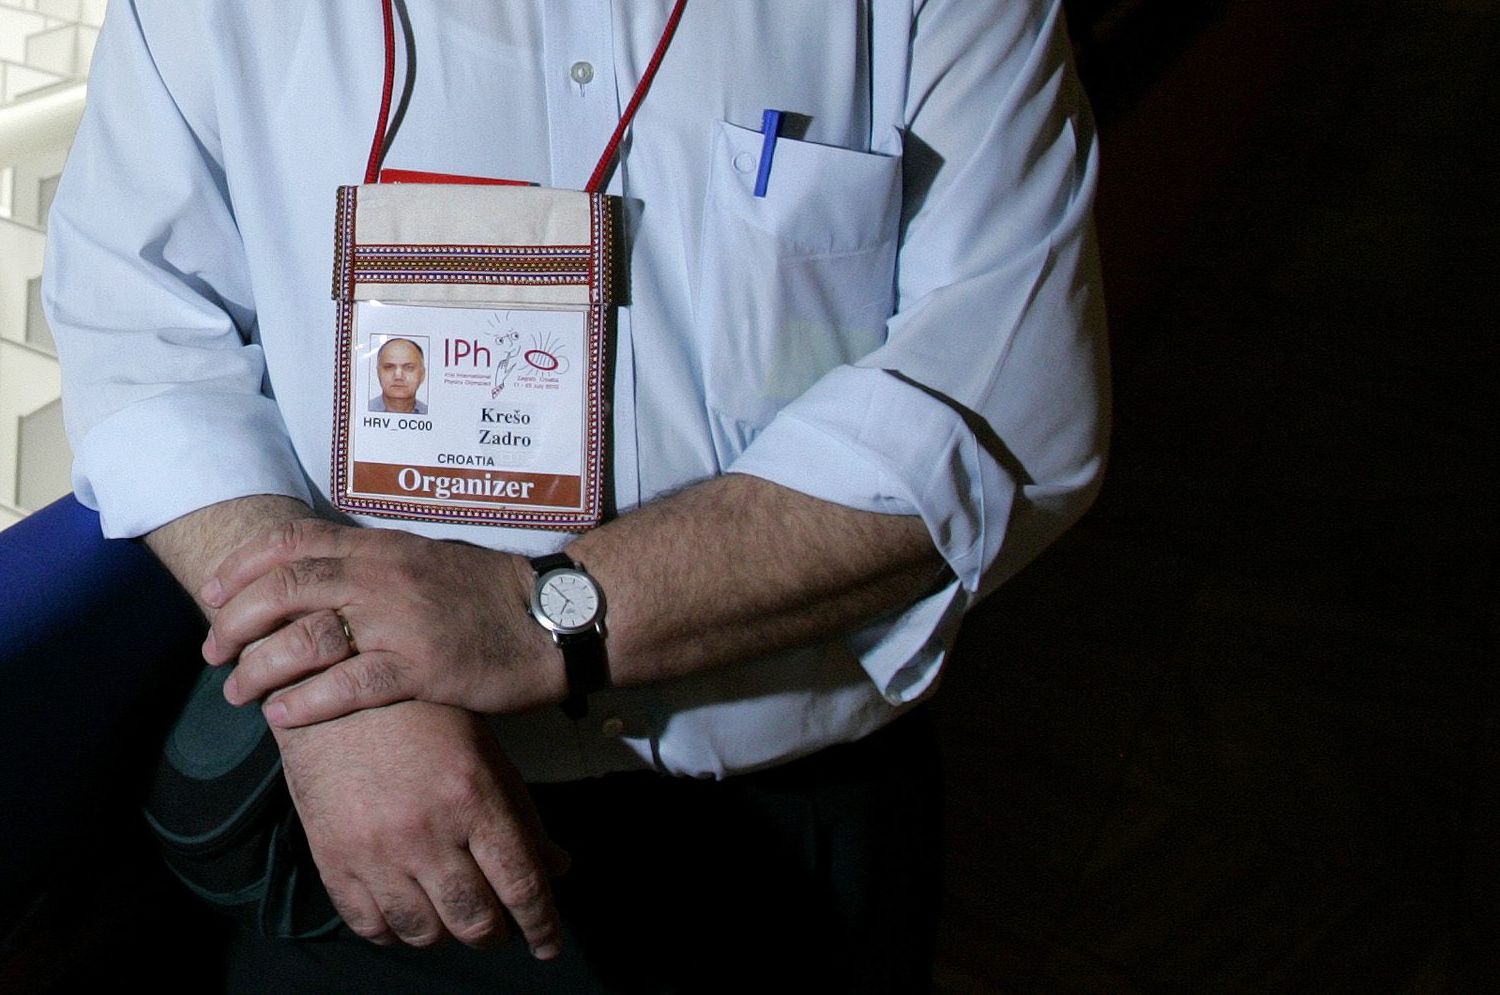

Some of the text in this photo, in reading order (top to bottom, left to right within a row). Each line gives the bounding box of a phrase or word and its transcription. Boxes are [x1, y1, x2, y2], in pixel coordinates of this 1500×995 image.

[363, 417, 433, 431] HRV_OC00
[481, 407, 531, 425] Krešo
[478, 430, 531, 447] Zadro
[437, 453, 495, 467] CROATIA
[397, 468, 535, 499] Organizer
